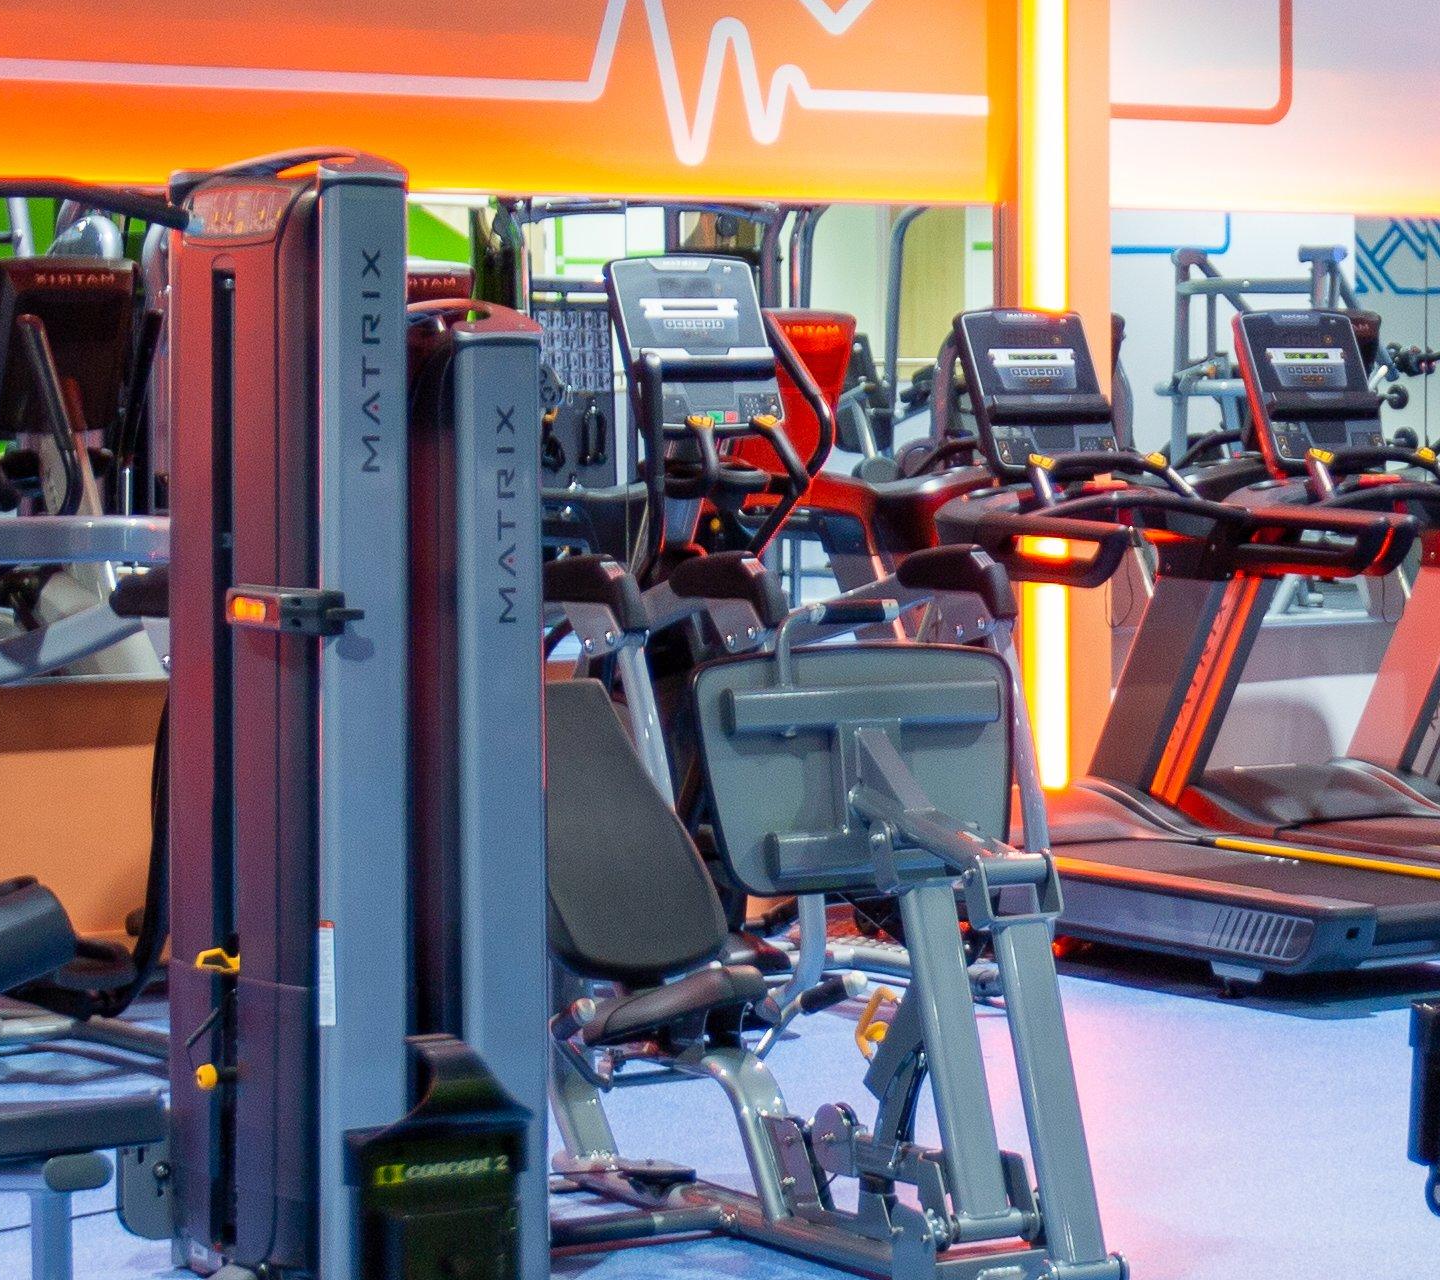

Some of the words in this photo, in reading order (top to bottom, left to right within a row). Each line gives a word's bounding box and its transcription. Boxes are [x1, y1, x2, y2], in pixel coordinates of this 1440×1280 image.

[362, 250, 381, 472] MATRIX
[496, 405, 516, 623] MATRIX
[406, 1157, 491, 1179] concept
[494, 1155, 509, 1170] 2
